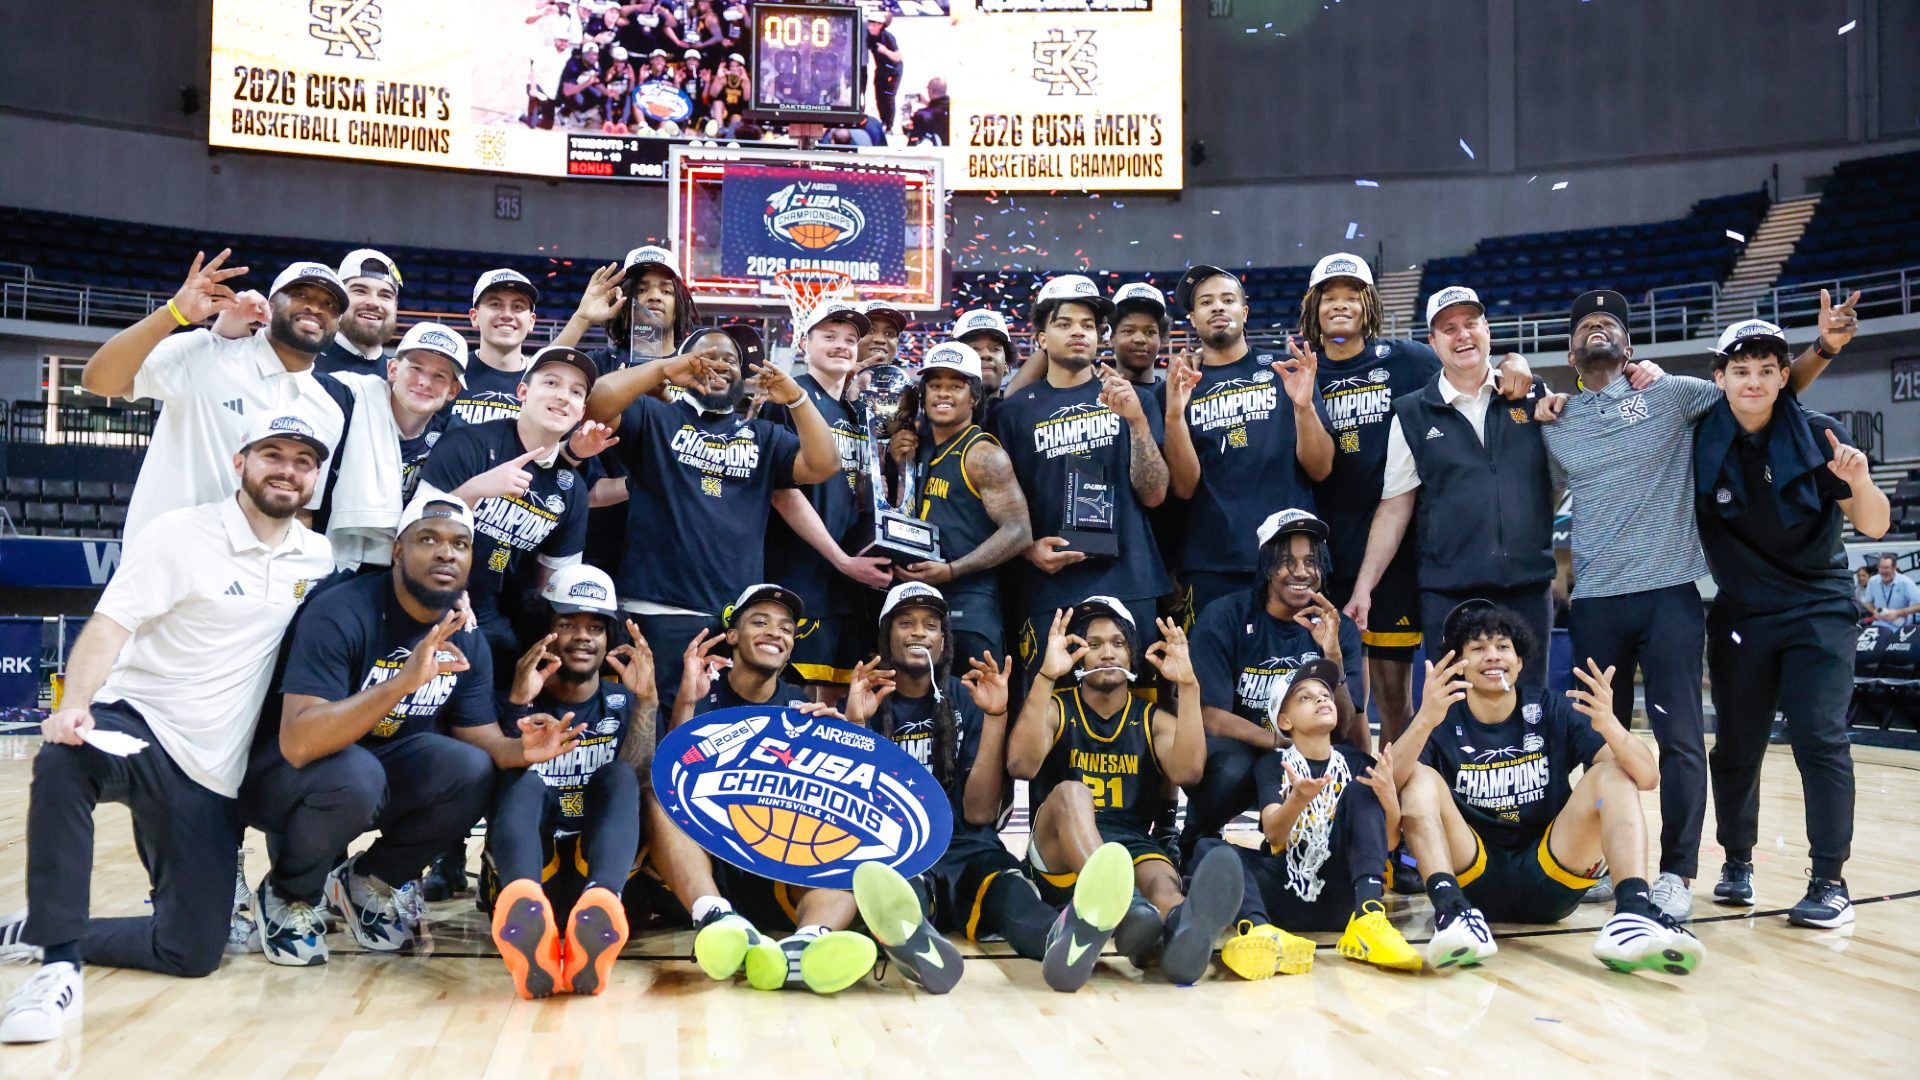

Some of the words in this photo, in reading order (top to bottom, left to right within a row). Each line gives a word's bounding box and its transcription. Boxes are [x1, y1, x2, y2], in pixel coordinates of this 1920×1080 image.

[234, 65, 296, 106] 2026
[306, 73, 366, 113] CUSA
[376, 81, 450, 121] MEN'S
[780, 103, 831, 111] DAKTRONICS
[232, 108, 340, 144] BASKETBALL
[348, 119, 450, 154] CHAMPIONS
[970, 114, 1022, 147] 2026
[1032, 114, 1085, 147] CUSA
[1095, 114, 1162, 147] MEN'S
[570, 138, 624, 151] TIMEOUTS
[630, 140, 639, 151] 2
[570, 150, 602, 161] FOULS
[969, 154, 1063, 178] BASKETBALL
[1070, 153, 1163, 178] CHAMPIONS
[570, 162, 613, 176] BONUS
[630, 164, 662, 176] POSS
[497, 197, 520, 219] 315
[778, 208, 850, 228] CHAMPIONSHIPS
[747, 255, 787, 277] 2026
[790, 258, 880, 281] CHAMPIONS
[1326, 263, 1357, 273] CHAMPIONS
[420, 335, 458, 353] CHAMPIONS
[931, 351, 962, 365] CHAMPIONS
[1354, 384, 1386, 394] BASKETBALL
[1190, 386, 1277, 426] CHAMPIONS
[272, 420, 314, 437] CHAMPIONS
[1203, 415, 1243, 431] KENNESAW
[1245, 411, 1269, 421] STATE
[1358, 413, 1383, 425] STATE
[1034, 413, 1120, 452] CHAMPIONS
[671, 429, 760, 469] CHAMPIONS
[1046, 441, 1088, 459] KENNESAW
[1090, 436, 1114, 449] STATE
[678, 453, 725, 473] KENNESAW
[725, 466, 751, 478] STATE
[511, 537, 537, 551] STATE
[571, 586, 607, 600] CHAMPIONS
[0, 657, 32, 673] RK
[409, 705, 438, 716] STATE
[714, 726, 749, 747] 2026
[811, 724, 843, 744] AIR
[842, 730, 876, 745] NATIONAL
[910, 732, 928, 740] MEN'S
[840, 738, 875, 752] GUARD
[1491, 760, 1510, 769] MEN'S
[1510, 752, 1543, 766] BASKETBALL
[1454, 756, 1550, 798] CHAMPIONS
[1082, 773, 1123, 808] 21
[1467, 795, 1515, 809] KENNESAW
[1517, 788, 1545, 805] STATE
[718, 772, 883, 834] CHAMPIONS
[758, 796, 822, 817] HUNTSVILLE
[824, 813, 837, 825] AL
